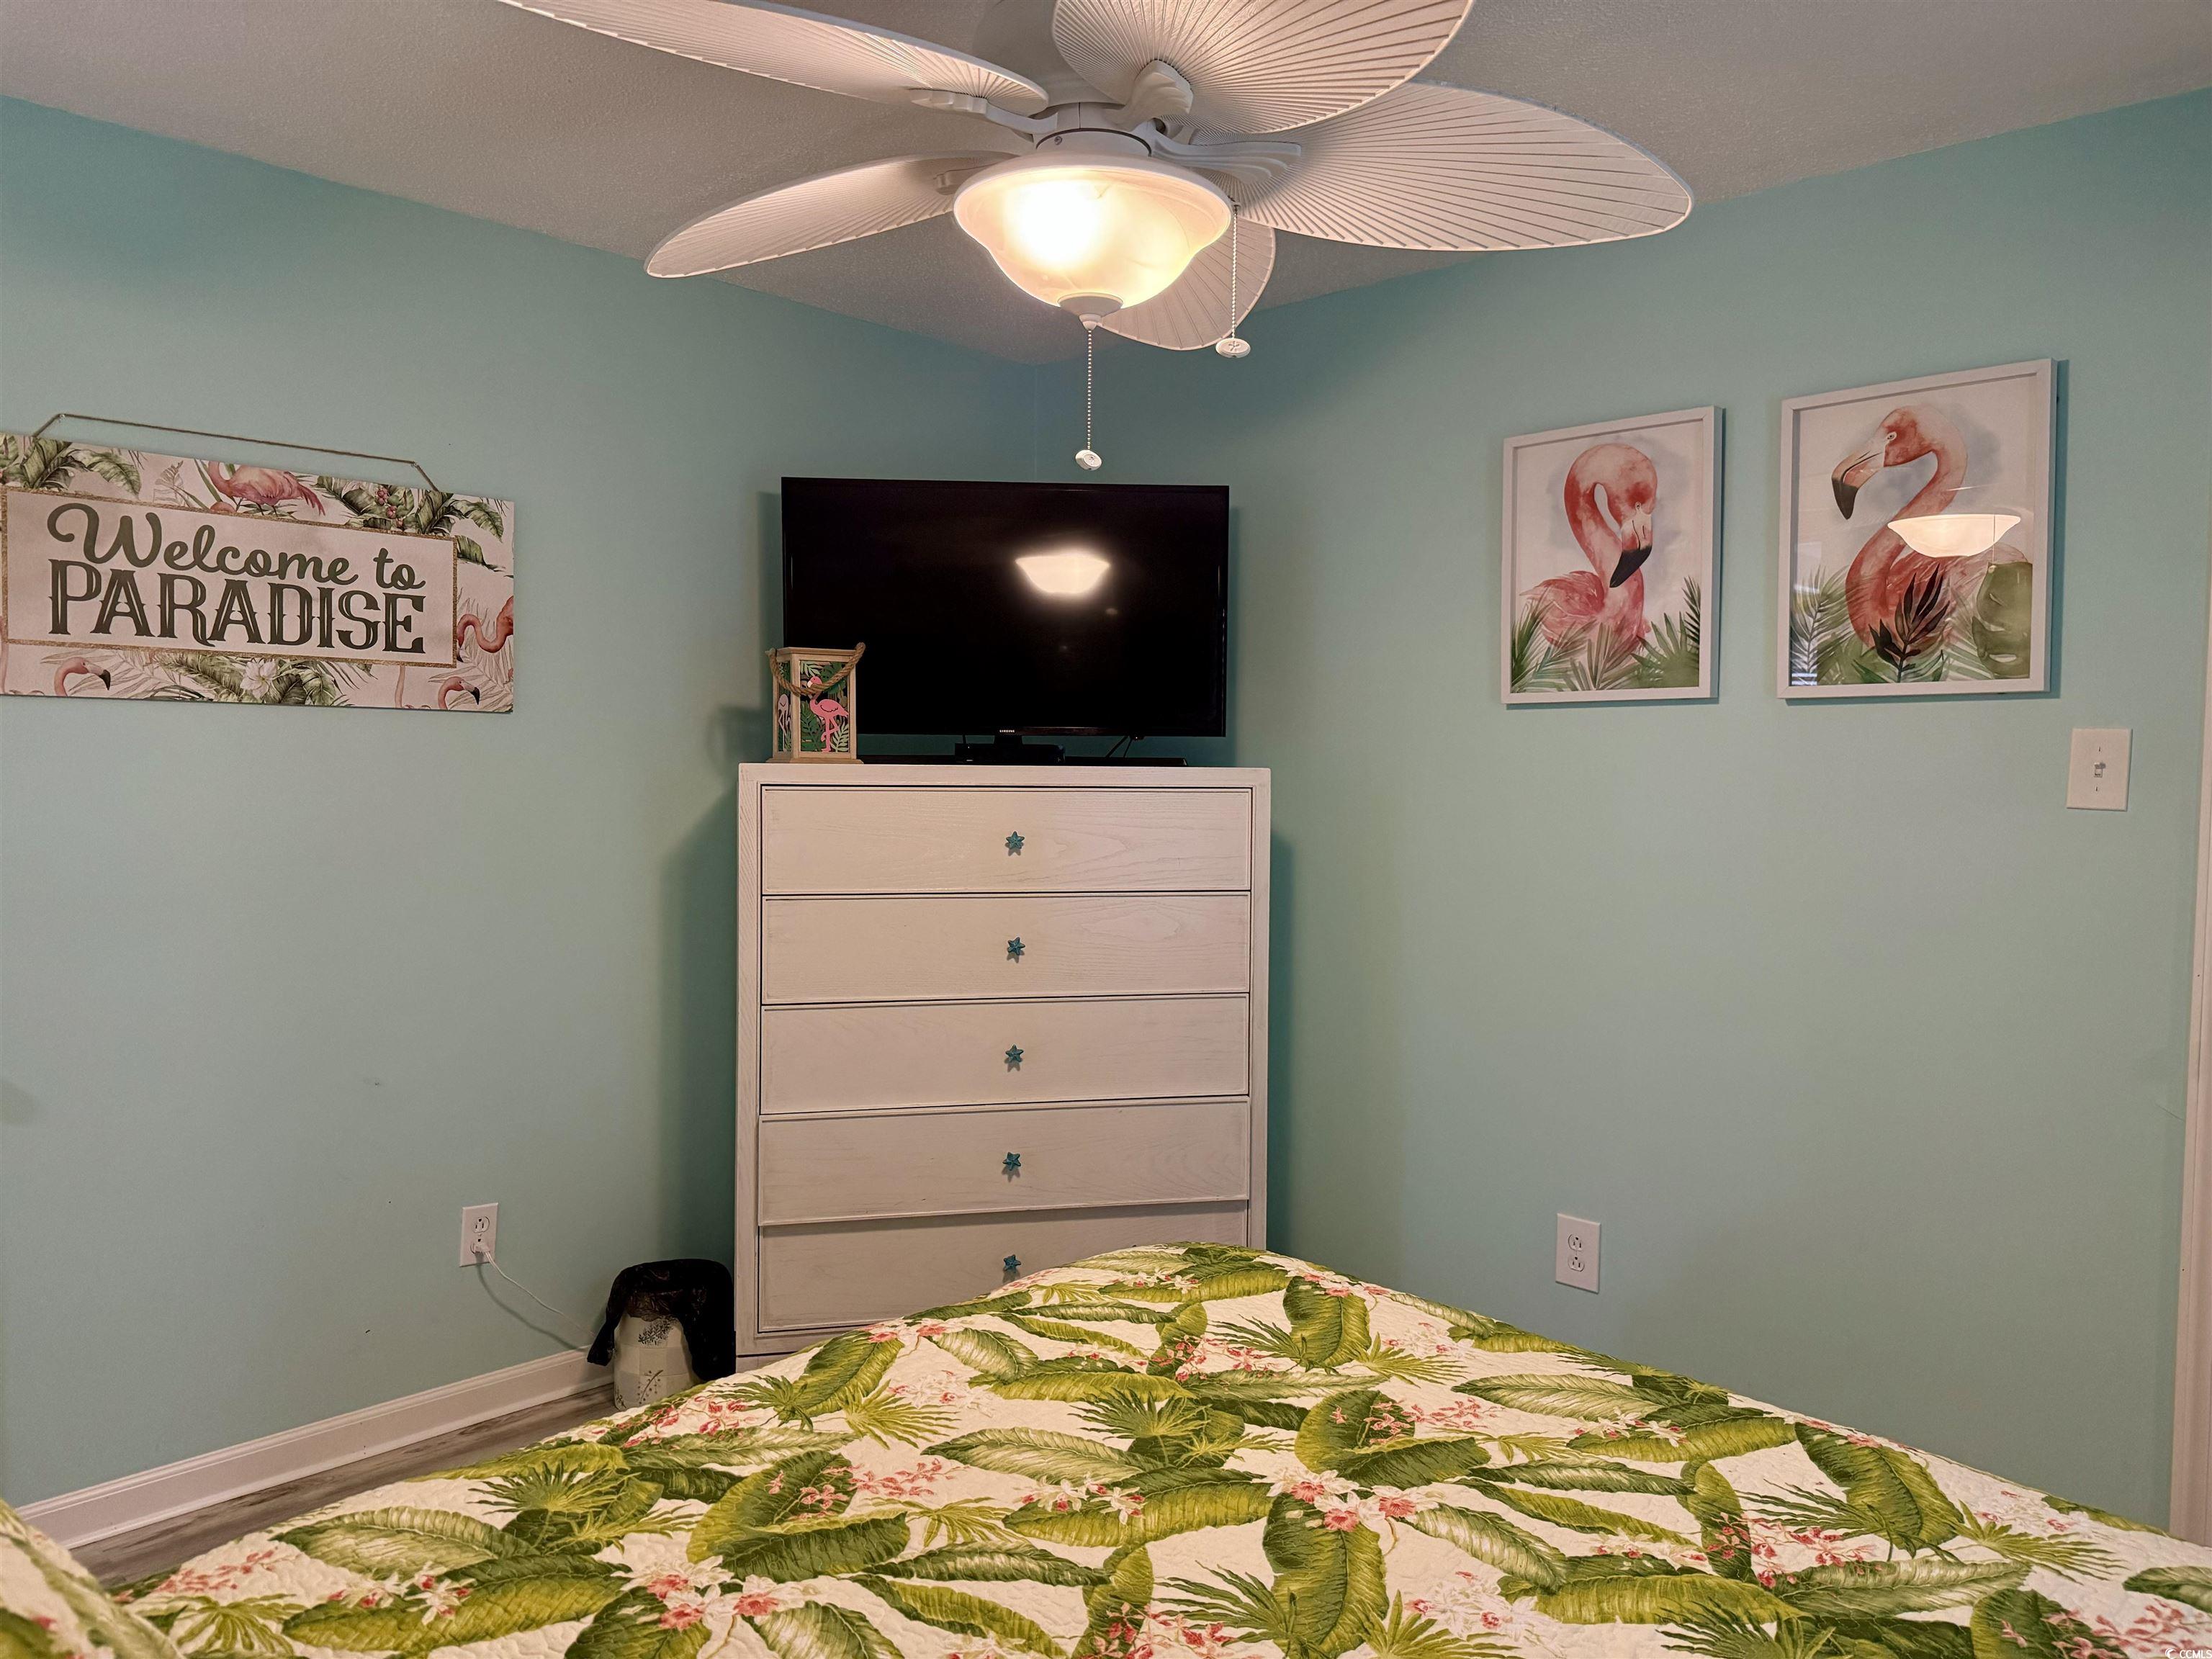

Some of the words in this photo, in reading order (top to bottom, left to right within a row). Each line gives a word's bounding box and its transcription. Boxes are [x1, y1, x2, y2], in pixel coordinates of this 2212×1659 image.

[47, 503, 359, 584] Welcome
[374, 547, 426, 590] to
[48, 559, 426, 654] PARADISE
